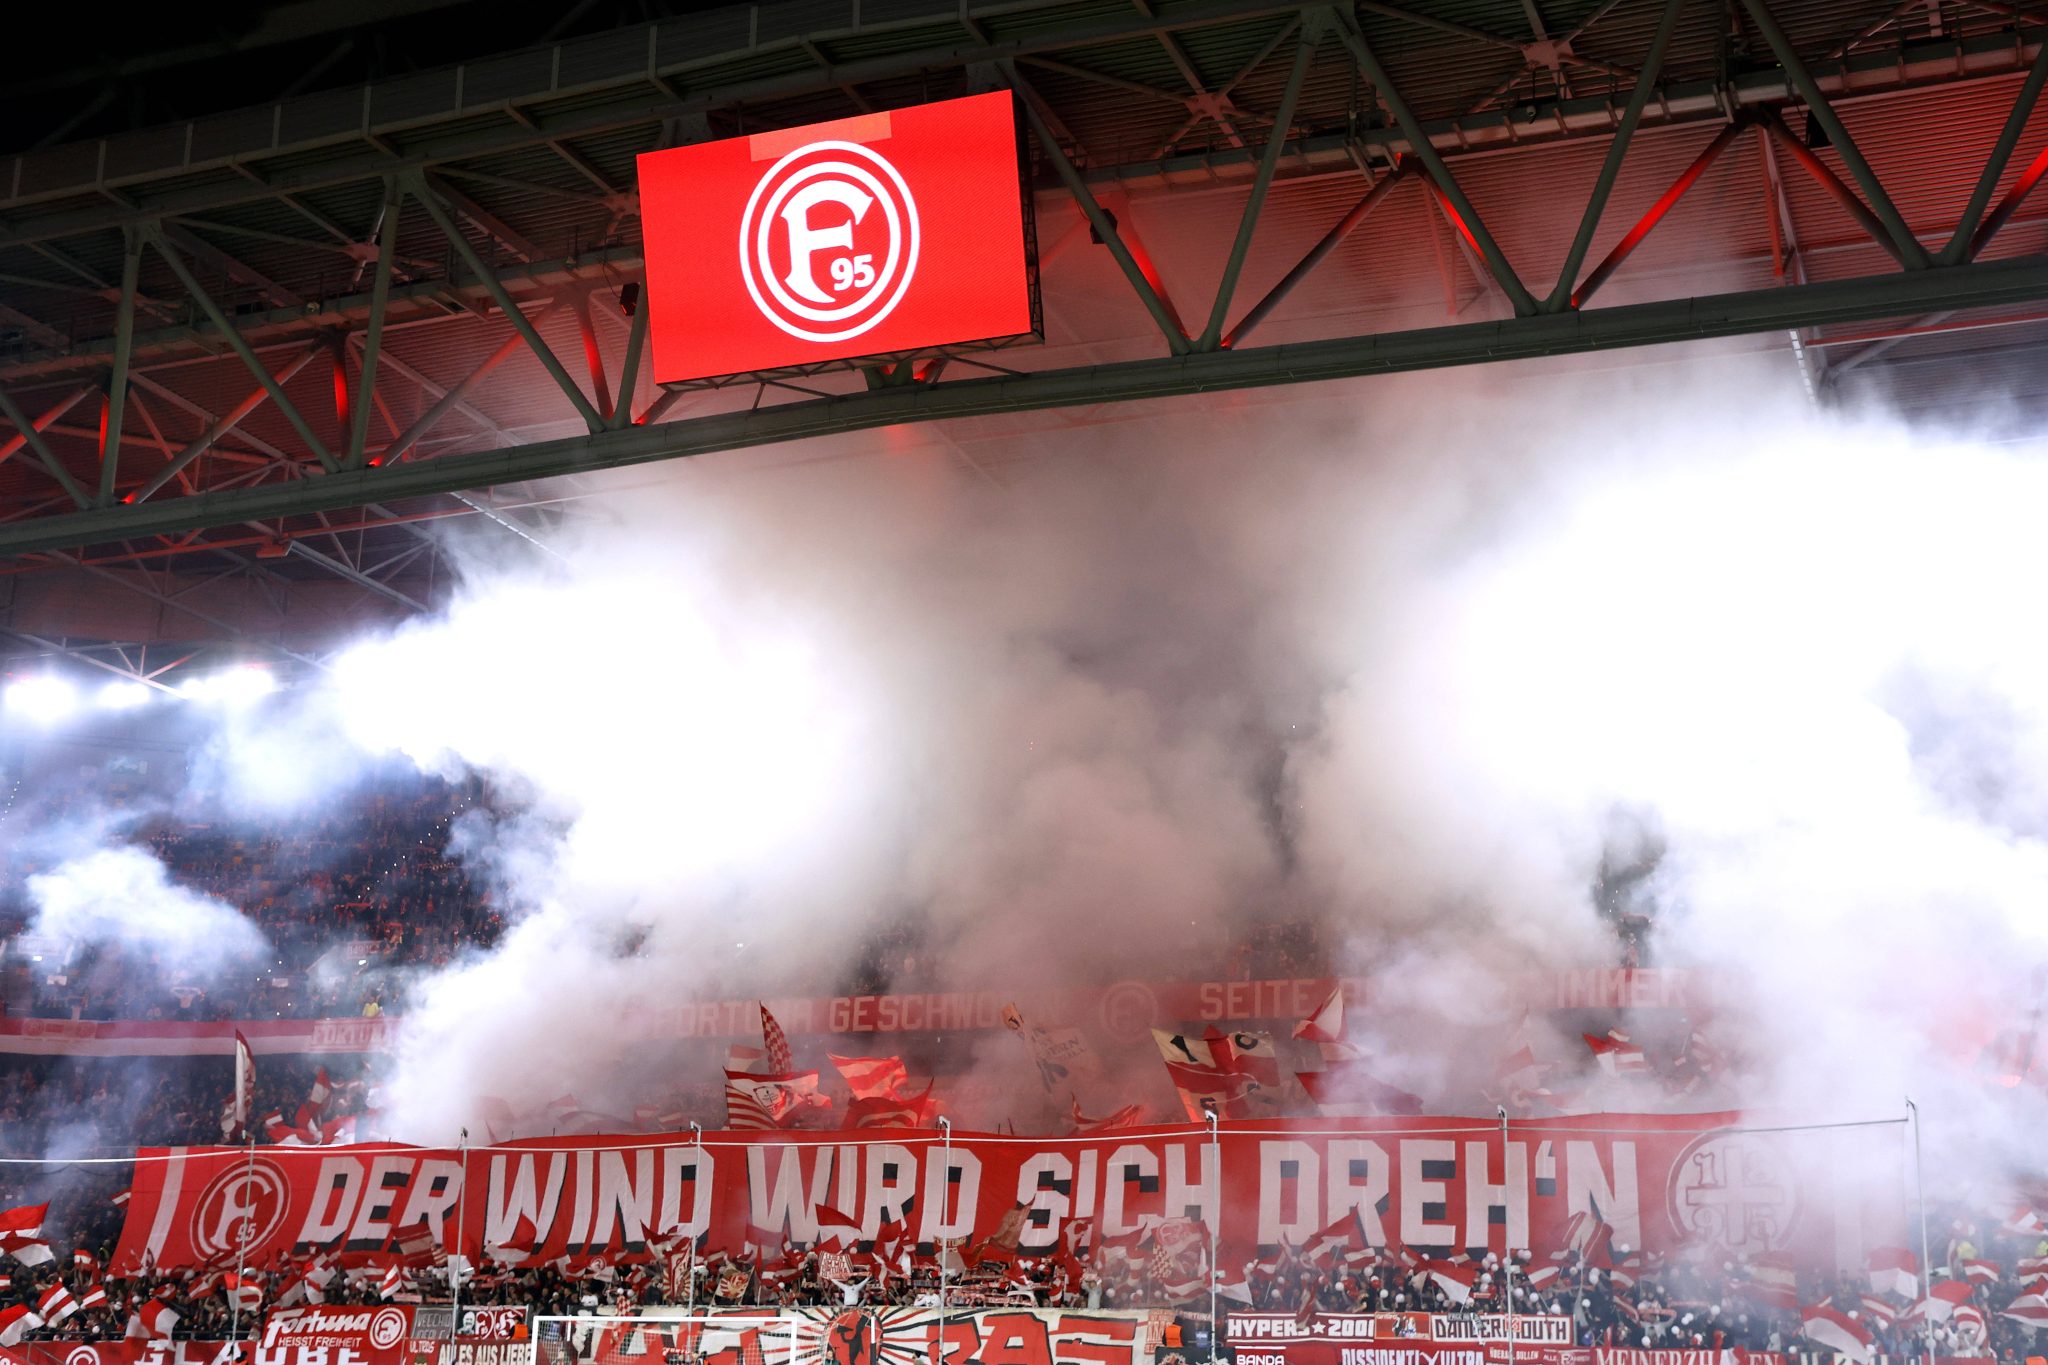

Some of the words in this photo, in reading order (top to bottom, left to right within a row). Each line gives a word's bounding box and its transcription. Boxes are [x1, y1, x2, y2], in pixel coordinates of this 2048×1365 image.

[830, 254, 875, 291] 95
[1200, 978, 1316, 1020] SEITE
[829, 989, 1062, 1033] GESCHWO
[299, 1155, 465, 1250] DER
[484, 1147, 715, 1247] WIND
[747, 1145, 983, 1243] WIRD
[1017, 1144, 1221, 1247] SICH
[264, 1308, 372, 1349] Fortuna
[1227, 1318, 1310, 1338] HYPERS
[1328, 1318, 1375, 1338] 2001
[278, 1336, 313, 1347] HEISST
[315, 1337, 362, 1348] FREIHEIT
[475, 1344, 498, 1365] AUS
[501, 1343, 532, 1365] LIEBE
[1236, 1354, 1285, 1365] BANDA
[1341, 1349, 1420, 1365] DISSIDENTI
[1596, 1348, 1779, 1365] MEINERZHEN
